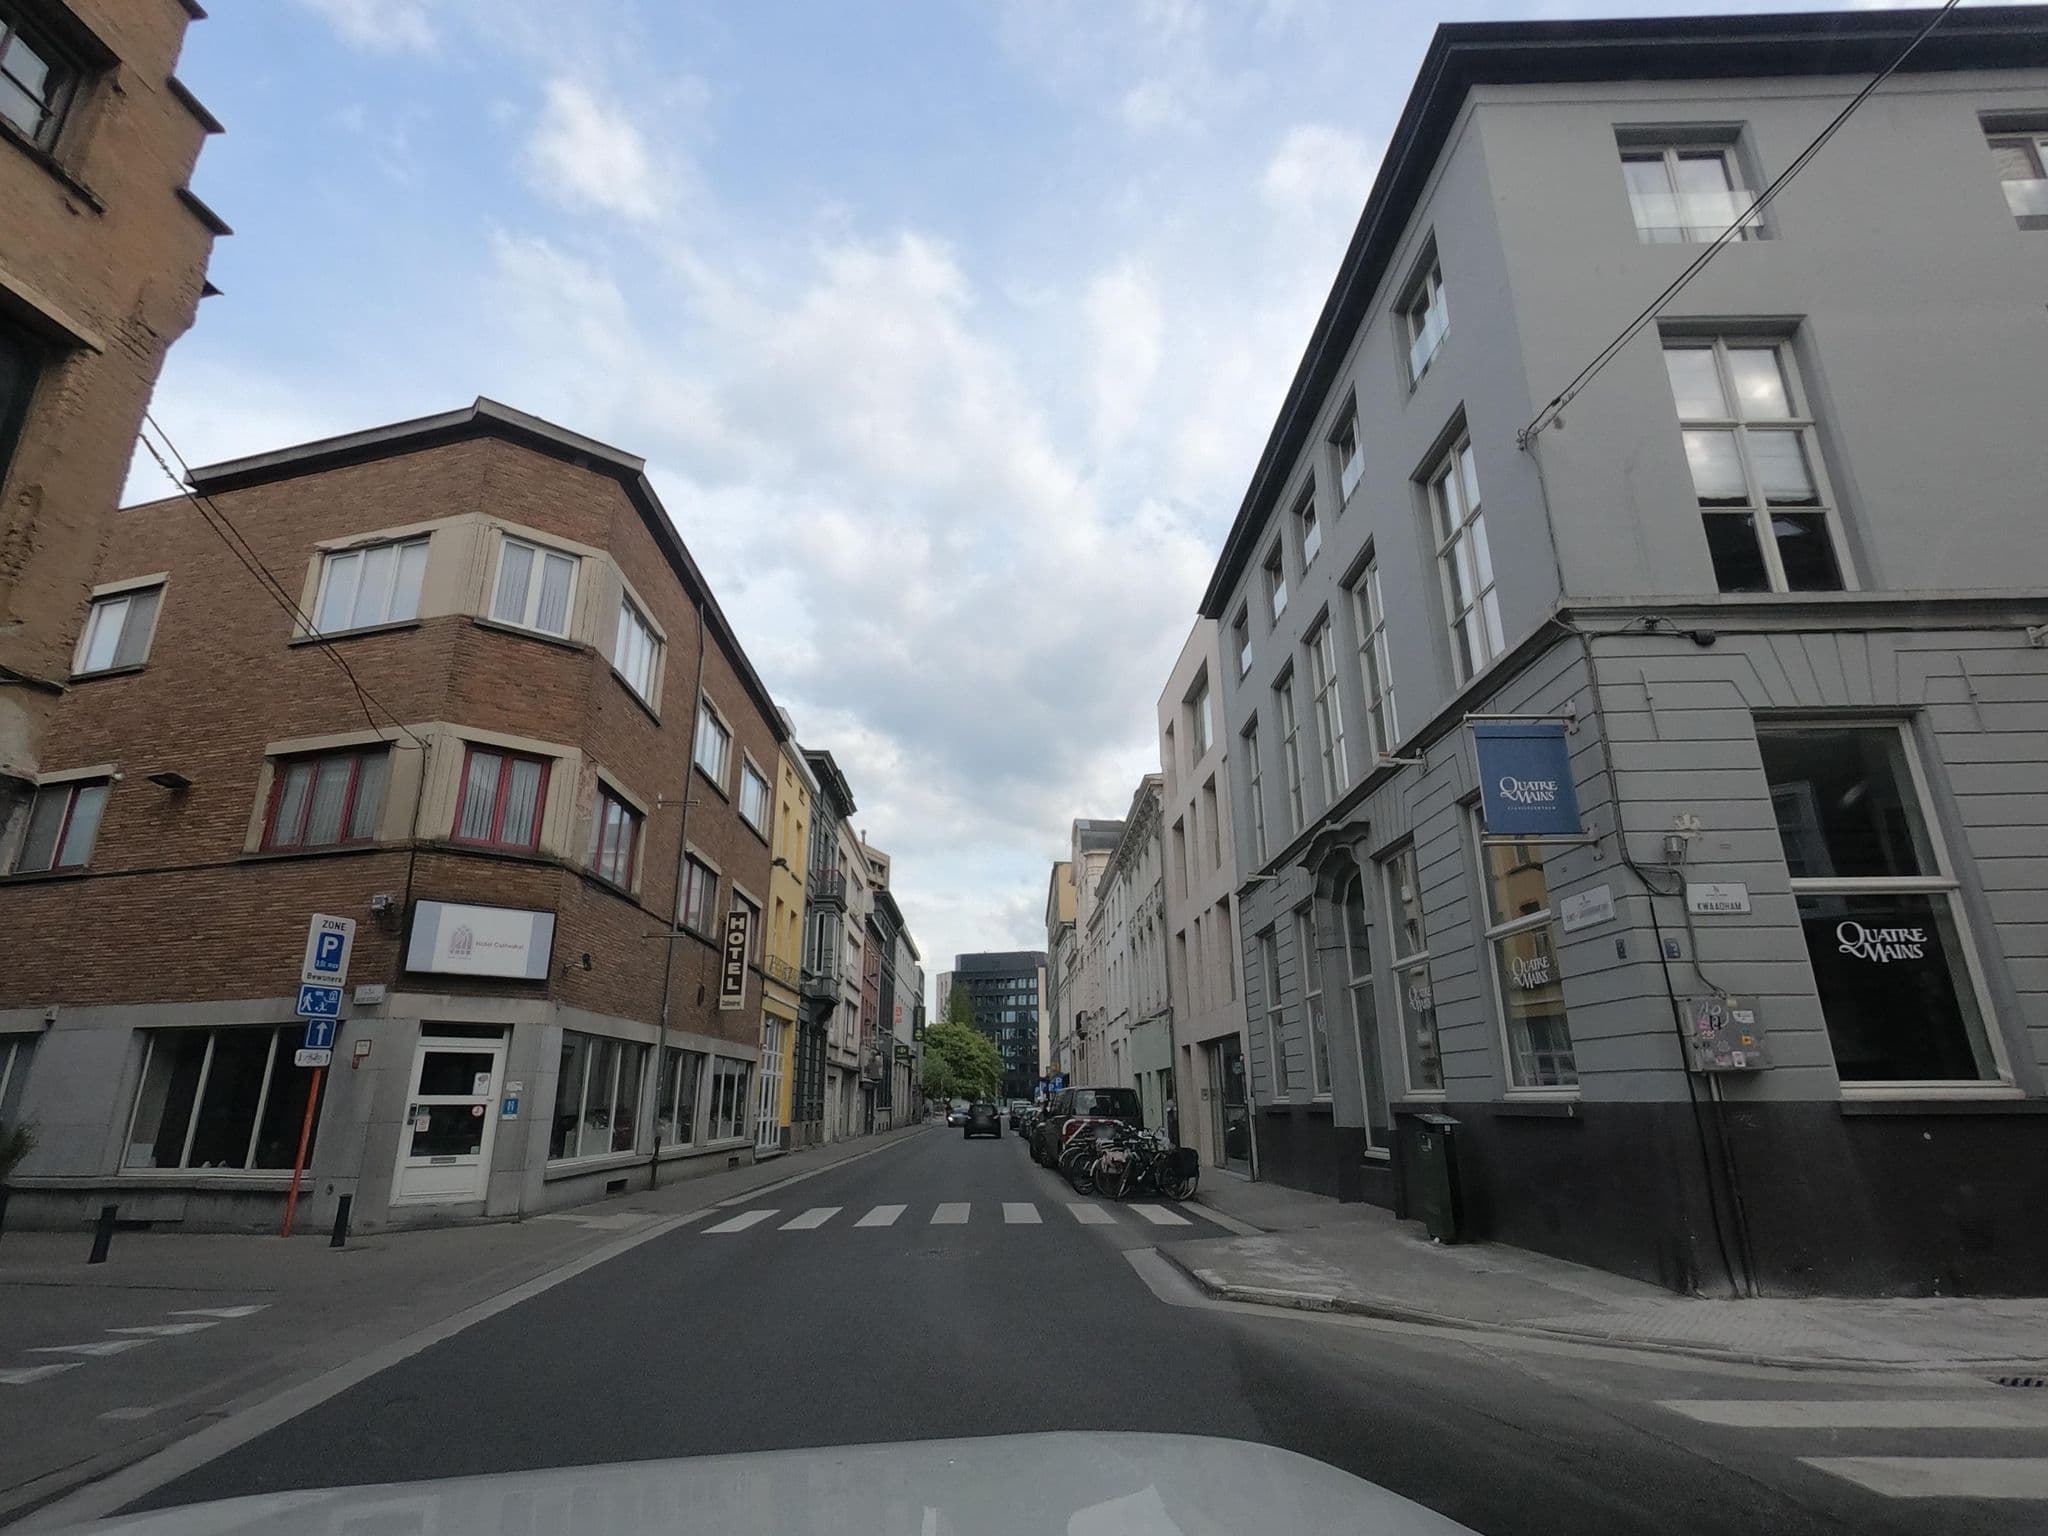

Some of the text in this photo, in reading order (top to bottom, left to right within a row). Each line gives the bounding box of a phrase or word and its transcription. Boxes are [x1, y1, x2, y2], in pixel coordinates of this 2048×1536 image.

[1499, 776, 1558, 799] QUATRE
[1516, 790, 1555, 804] MAINS
[322, 919, 347, 931] ZONE
[1836, 920, 1928, 953] QUATRE
[321, 935, 339, 958] P
[727, 917, 746, 990] HOTEL
[1864, 942, 1925, 963] MAINS
